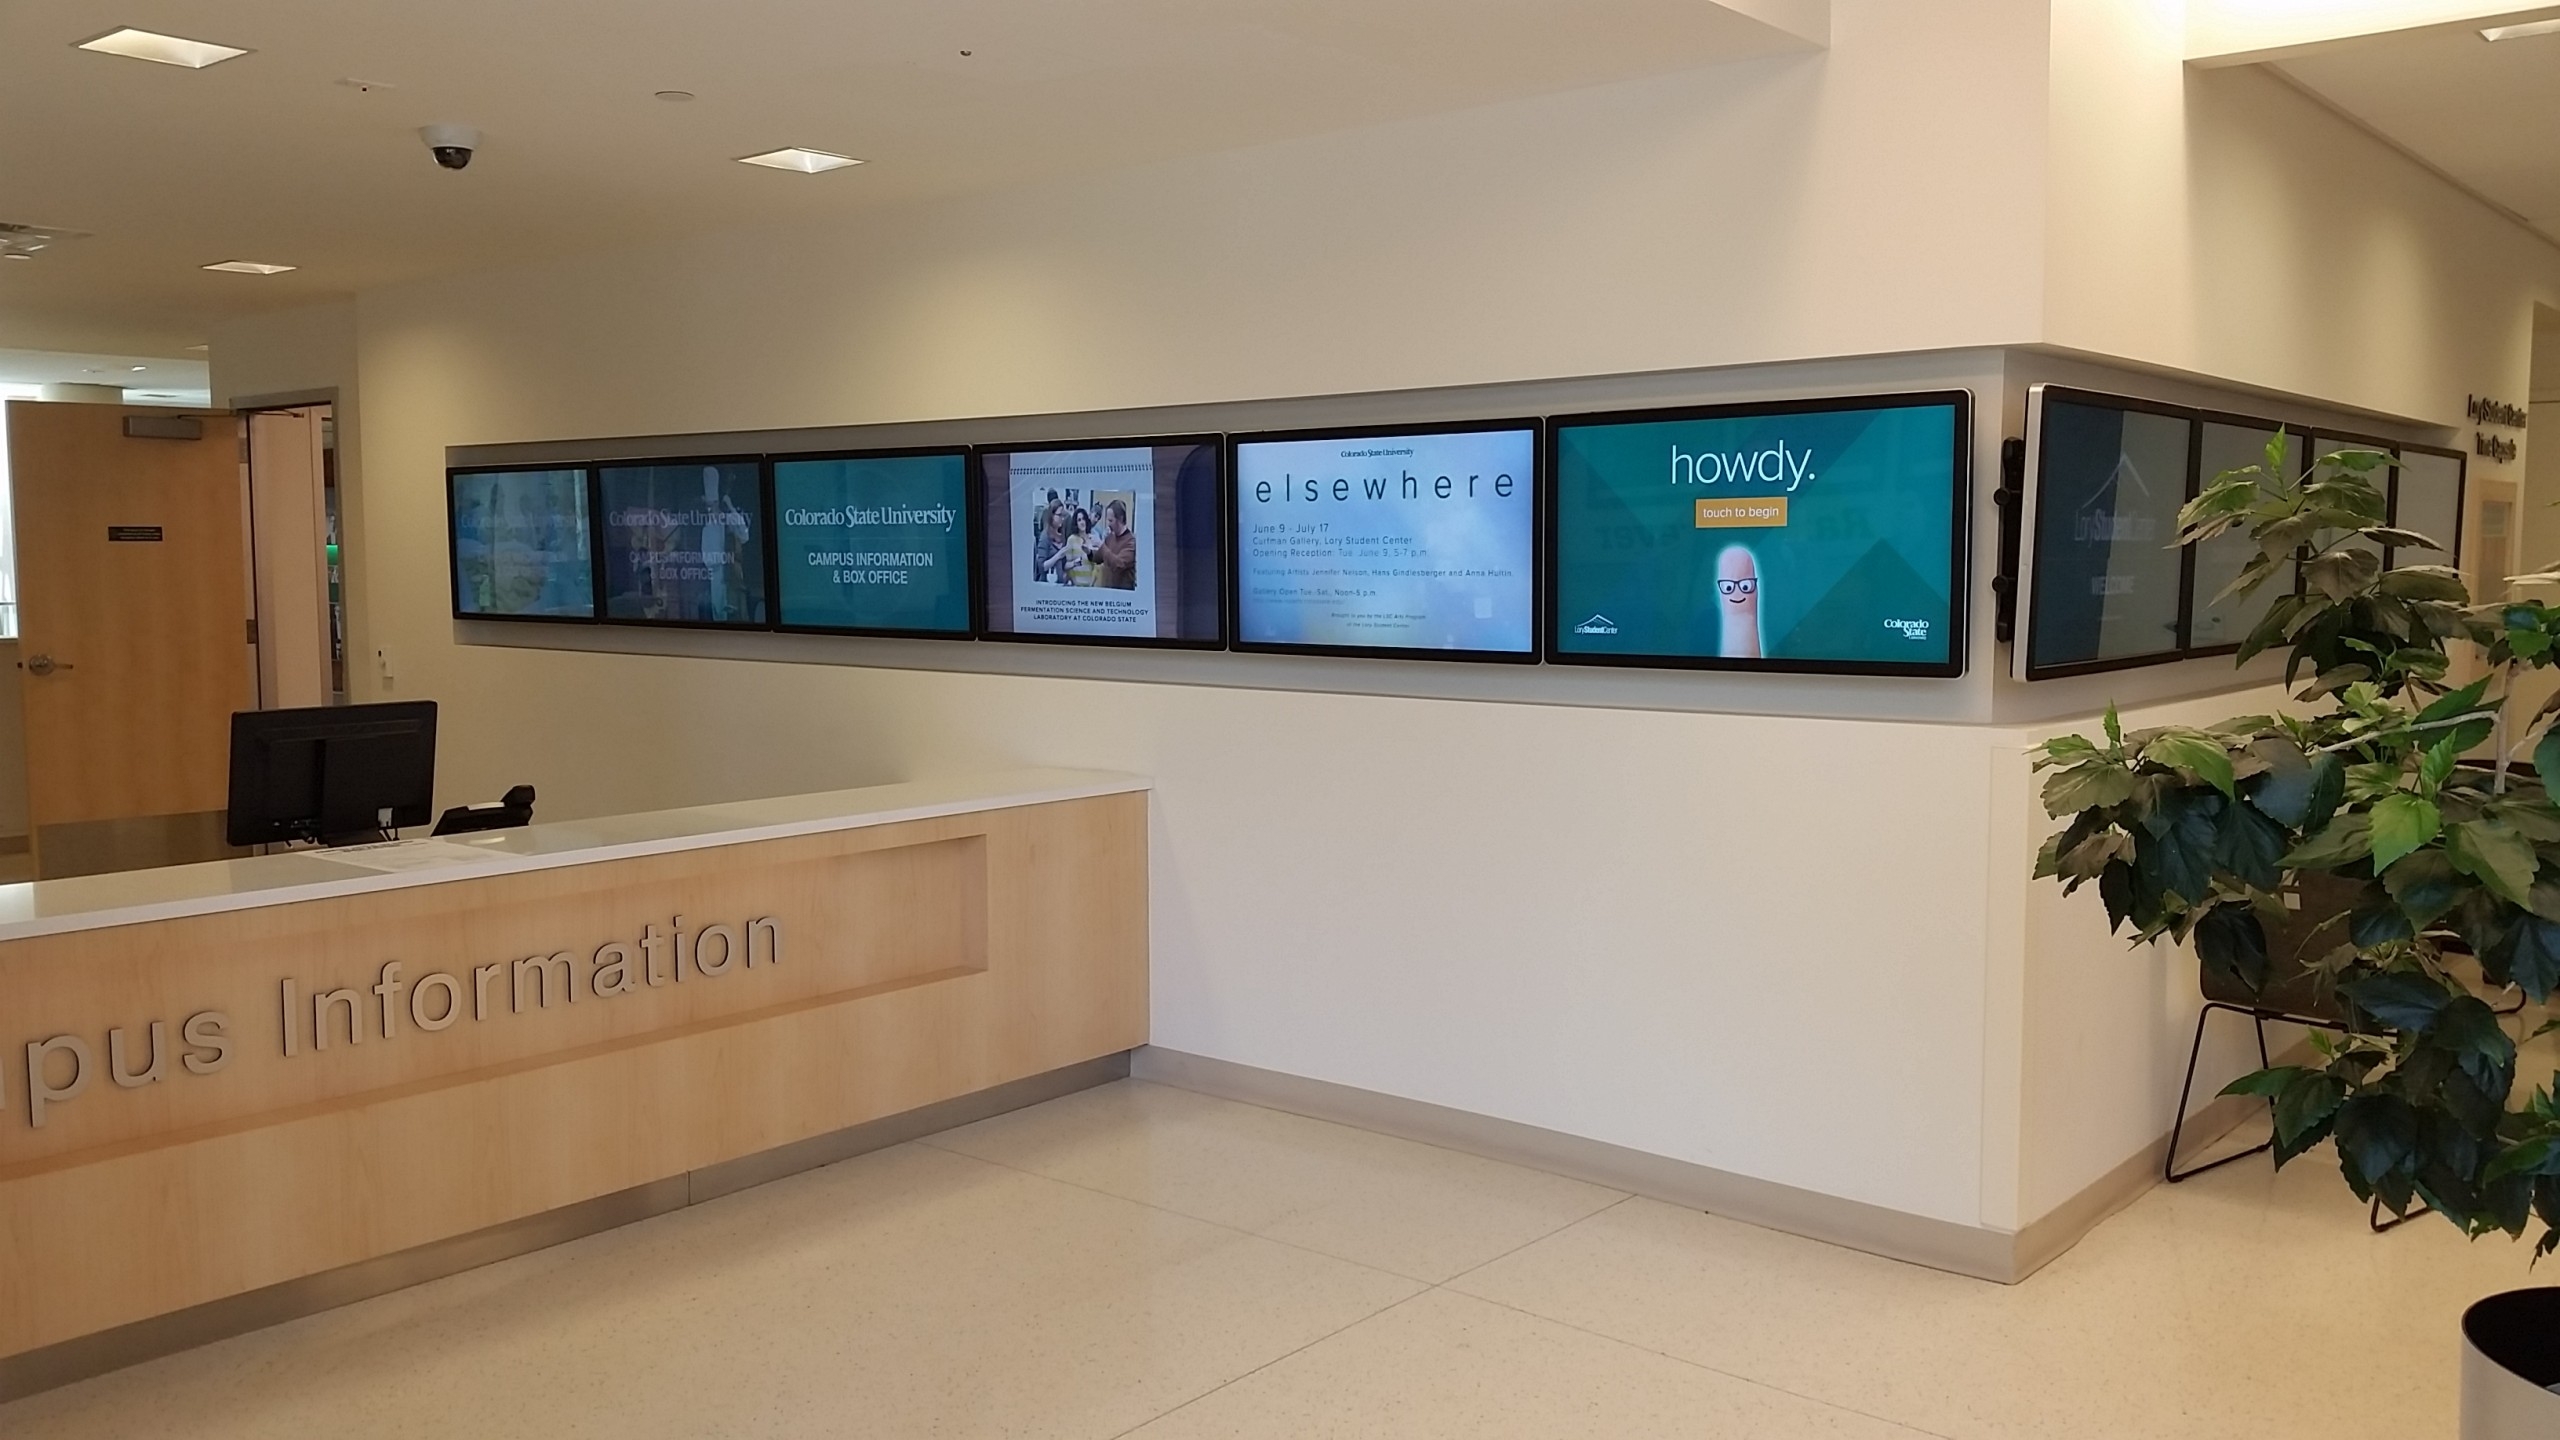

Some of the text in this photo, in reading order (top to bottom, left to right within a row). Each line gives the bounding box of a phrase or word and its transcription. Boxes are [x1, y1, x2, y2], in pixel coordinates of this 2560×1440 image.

[1340, 447, 1414, 458] Colorado State University
[1671, 439, 1816, 492] howdy.
[1255, 469, 1514, 503] elsewhere
[609, 509, 660, 527] Colorado
[660, 507, 690, 528] State
[690, 506, 753, 532] University
[785, 502, 957, 533] Colorado State University
[1703, 506, 1780, 520] touch to begin
[1252, 523, 1276, 534] June
[1279, 523, 1286, 533] 9
[1296, 523, 1316, 535] July
[1320, 522, 1329, 533] 17
[1324, 536, 1343, 547] Lory
[1345, 536, 1380, 546] Student
[1383, 535, 1413, 545] Center
[808, 552, 934, 566] CAMPUS INFORMATION
[1252, 548, 1288, 558] Opening
[1359, 548, 1379, 557] June
[833, 569, 908, 585] & BOX OFFICE
[1448, 569, 1463, 577] and
[1465, 569, 1486, 577] Anna
[1035, 599, 1076, 607] INTRODUCING
[1106, 608, 1149, 616] TECHNOLOGY
[1883, 618, 1930, 629] Colorado
[1903, 627, 1927, 638] State
[0, 914, 782, 1129] pus Information
